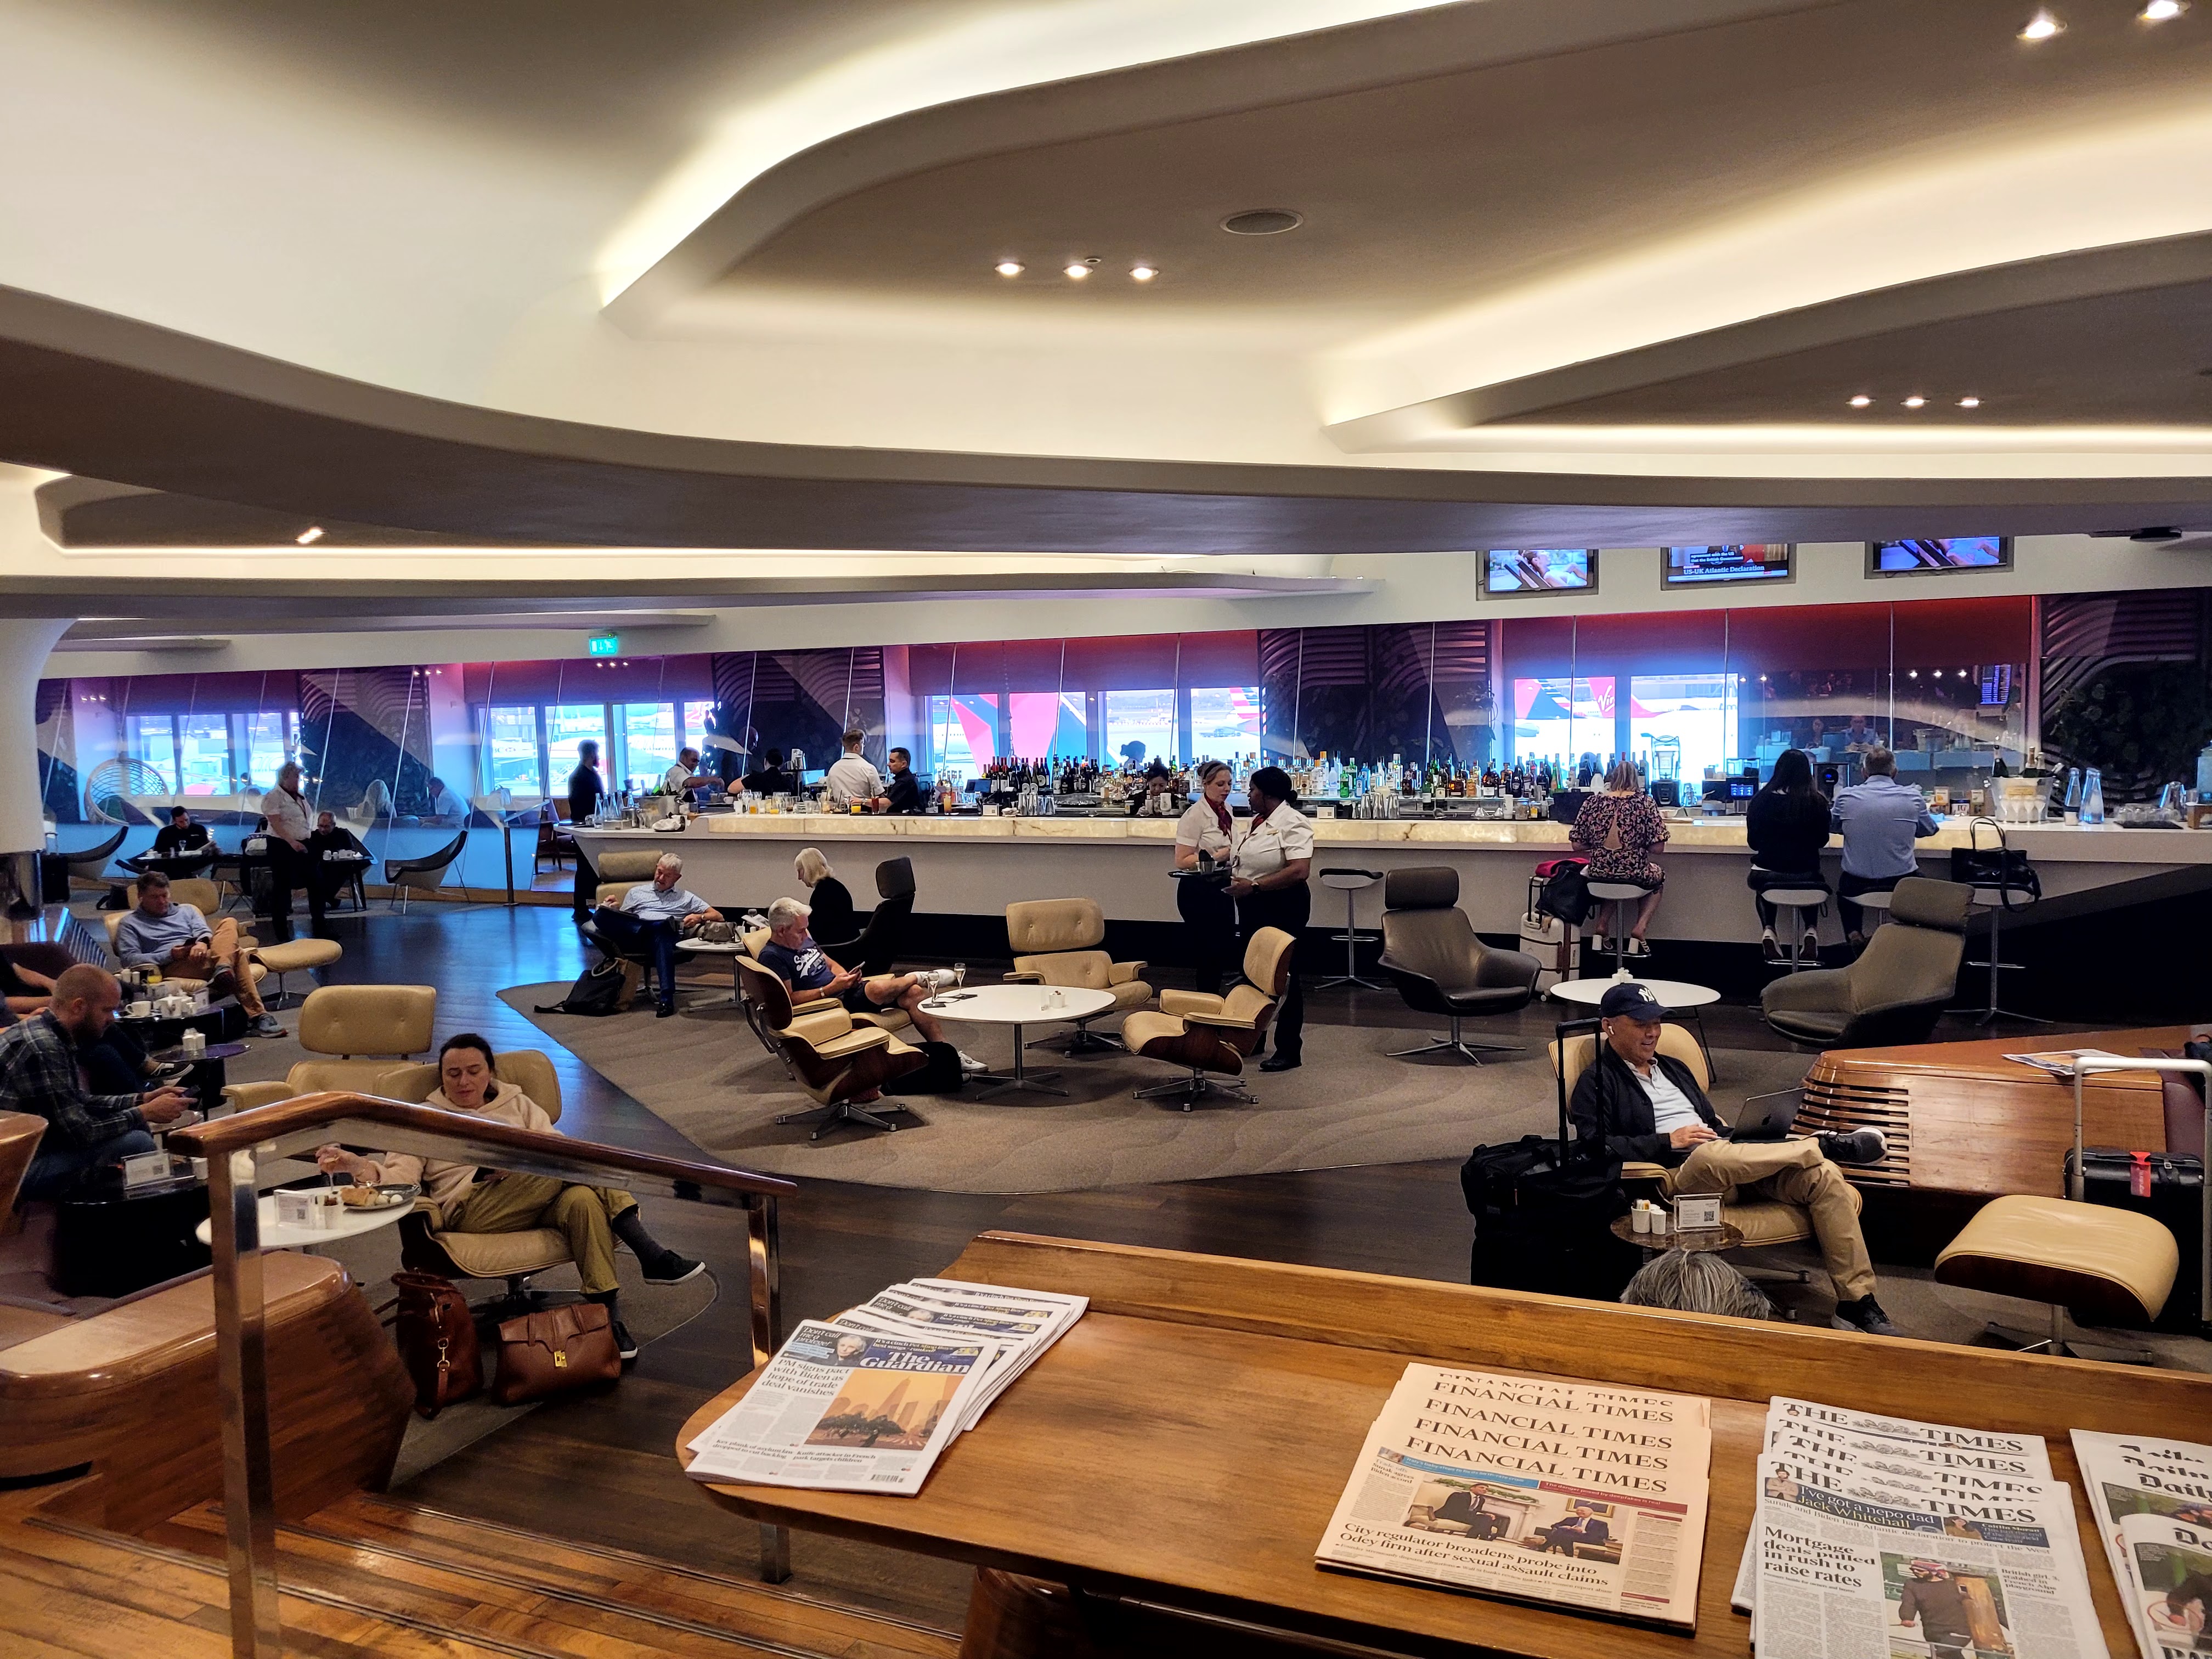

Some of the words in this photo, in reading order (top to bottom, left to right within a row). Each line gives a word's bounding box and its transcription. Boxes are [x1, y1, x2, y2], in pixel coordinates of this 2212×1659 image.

[777, 1359, 796, 1367] PM
[797, 1362, 825, 1373] signs
[859, 1357, 970, 1373] Guardian
[888, 1351, 931, 1364] The
[767, 1372, 795, 1383] hope
[809, 1380, 838, 1389] trade
[772, 1366, 796, 1375] with
[799, 1371, 831, 1381] Biden
[761, 1380, 786, 1389] deal
[787, 1384, 836, 1396] vanishes
[1433, 1381, 1580, 1411] FINANCIAL
[1586, 1402, 1674, 1423] TIMES
[1424, 1398, 1575, 1435] FINANCIAL
[1582, 1426, 1672, 1449] TIMES
[1783, 1403, 1848, 1425] THE
[1920, 1428, 2023, 1452] TIMES
[1414, 1417, 1568, 1455] FINANCIAL
[1576, 1446, 1668, 1470] TIMES
[1779, 1419, 1846, 1446] THE
[1919, 1449, 2026, 1472] TIMES
[1789, 1435, 1857, 1464] THE
[1370, 1467, 1390, 1477] Biden
[1390, 1475, 1413, 1483] accord
[1373, 1463, 1392, 1473] Sunak
[1393, 1471, 1414, 1480] agrees
[1406, 1436, 1565, 1475] FINANCIAL
[1572, 1466, 1667, 1492] TIMES
[1609, 1493, 1641, 1502] deepfakes
[1770, 1460, 1842, 1492] THE
[1921, 1498, 2036, 1523] TIMES
[1800, 1485, 1825, 1501] I've
[1827, 1496, 1851, 1508] got
[1854, 1503, 1863, 1511] a
[1866, 1505, 1904, 1520] nepo
[1906, 1513, 1934, 1523] dad
[1798, 1495, 1831, 1511] Jack
[1831, 1505, 1911, 1529] Whitehall
[1764, 1497, 1792, 1509] Sunak
[1795, 1504, 1811, 1515] and
[1814, 1510, 1840, 1524] Biden
[1842, 1519, 1859, 1528] hail
[1971, 1540, 2003, 1549] protect
[2006, 1543, 2023, 1551] the
[2025, 1546, 2051, 1555] West
[1345, 1523, 1376, 1536] City
[1376, 1530, 1444, 1548] regulator
[1446, 1542, 1515, 1560] broadens
[1516, 1556, 1563, 1569] probe
[1565, 1564, 1597, 1575] into
[1764, 1539, 1812, 1555] deals
[1765, 1526, 1854, 1555] Mortgage
[1340, 1533, 1379, 1547] Odey
[1380, 1539, 1412, 1553] firm
[1414, 1546, 1451, 1559] after
[1452, 1554, 1499, 1568] sexual
[1502, 1562, 1555, 1578] assault
[1558, 1572, 1609, 1585] claims
[1764, 1549, 1782, 1560] in
[1788, 1554, 1830, 1568] rush
[1836, 1562, 1855, 1572] to
[1764, 1561, 1810, 1577] raise
[1815, 1570, 1862, 1588] rates
[2001, 1568, 2031, 1577] British
[2003, 1574, 2037, 1583] stabbed
[2004, 1579, 2034, 1588] French
[2005, 1583, 2055, 1595] playground
